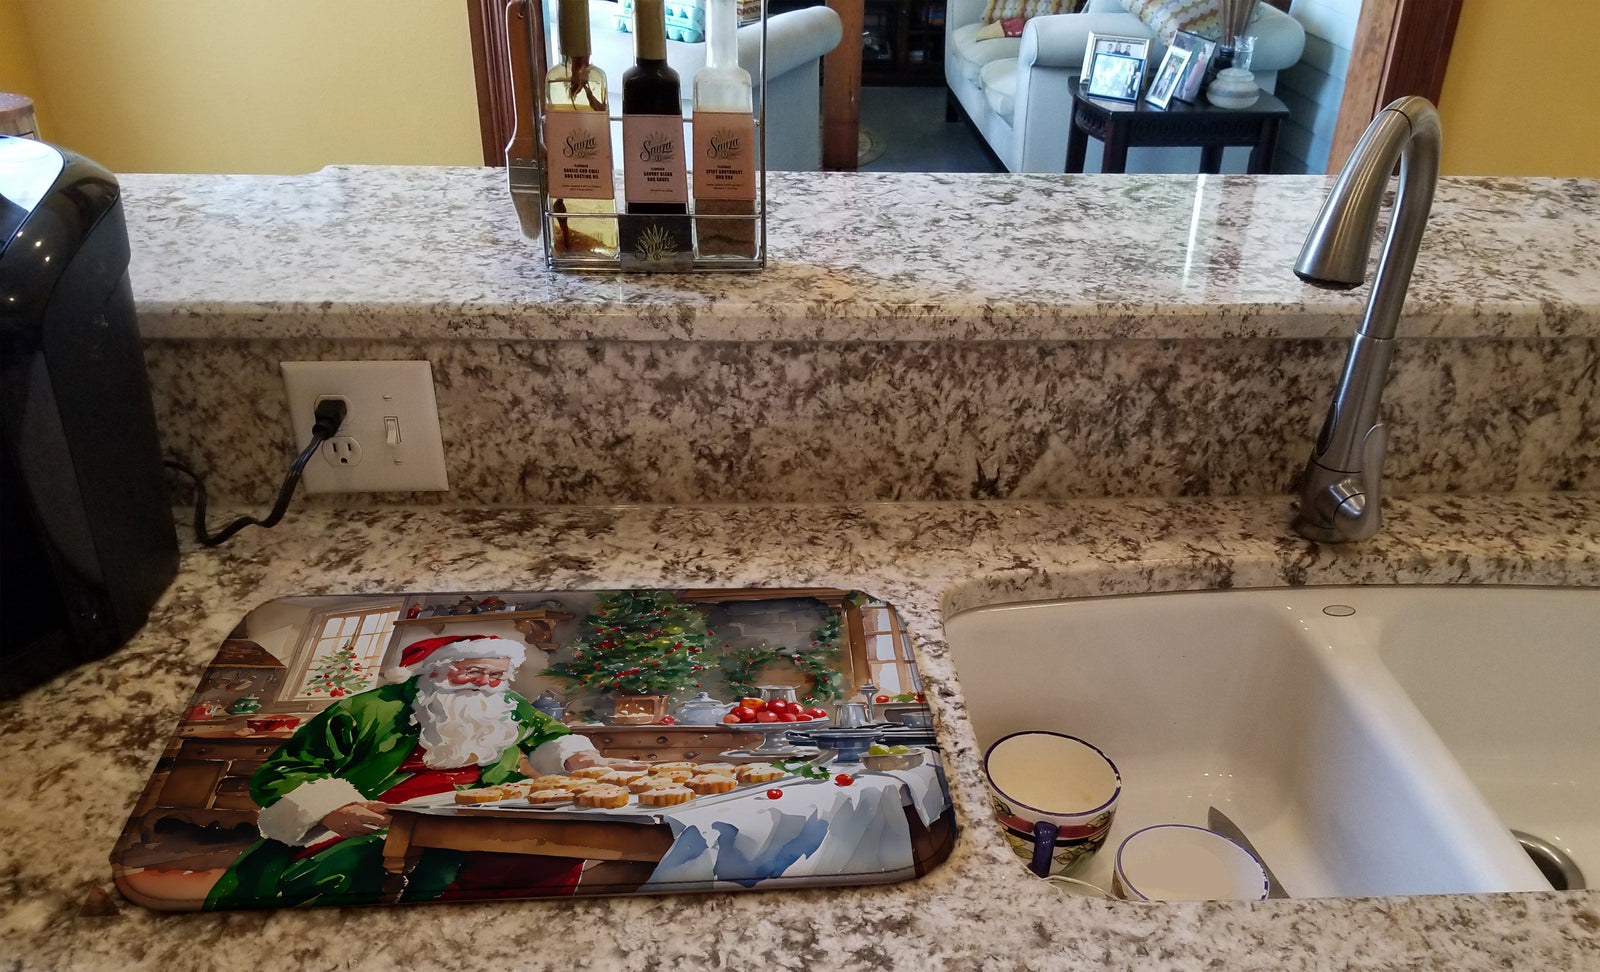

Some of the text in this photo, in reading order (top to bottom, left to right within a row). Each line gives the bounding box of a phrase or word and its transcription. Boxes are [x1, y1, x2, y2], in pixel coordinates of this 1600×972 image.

[563, 136, 597, 158] Sauza
[640, 140, 673, 162] Sauza
[707, 136, 740, 159] Sauza
